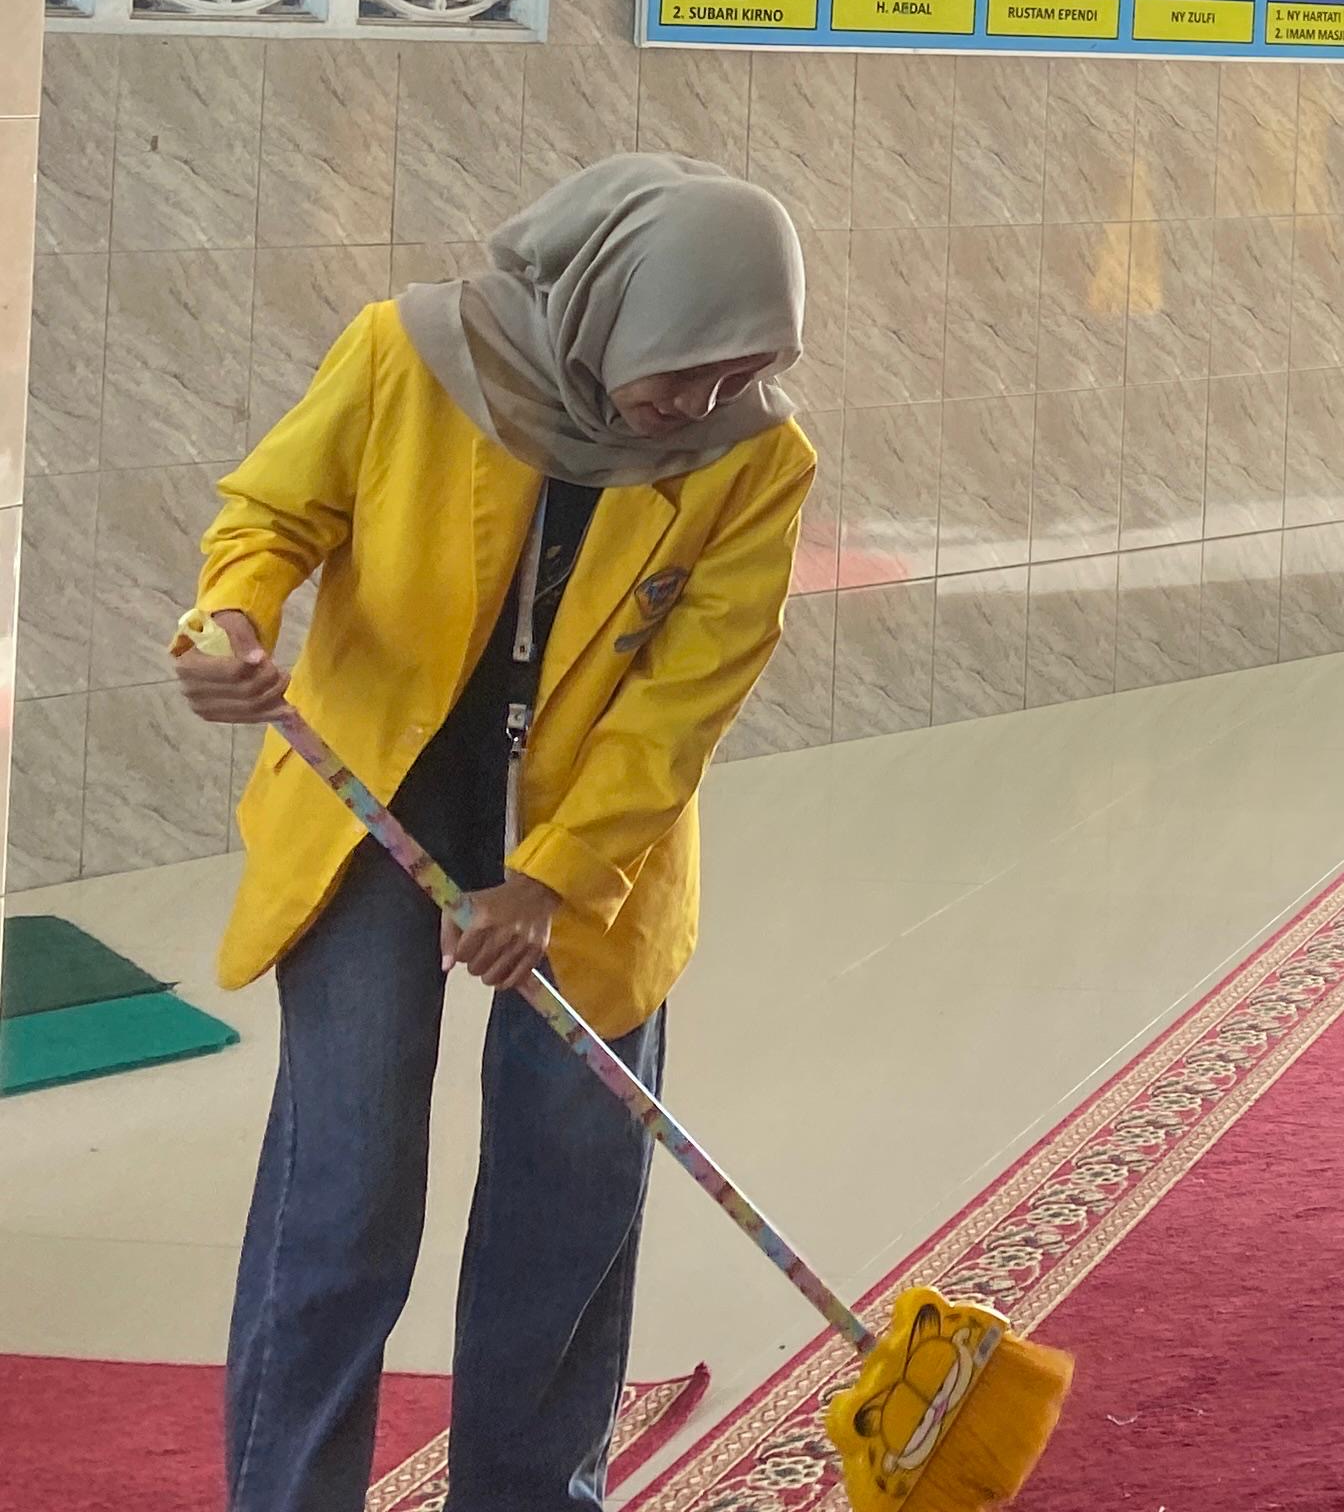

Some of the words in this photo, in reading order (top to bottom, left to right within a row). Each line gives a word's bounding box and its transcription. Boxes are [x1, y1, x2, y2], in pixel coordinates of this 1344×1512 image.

[876, 1, 888, 13] H.
[673, 6, 685, 19] 2.
[689, 7, 738, 21] SUBARI
[742, 9, 783, 22] KIRNO
[1008, 6, 1055, 20] RUSTAM
[1058, 8, 1098, 21] EPENDI
[1171, 11, 1185, 23] NY
[1188, 13, 1215, 23] ZULFI
[1287, 11, 1300, 21] NY
[1303, 11, 1341, 22] HARTATI
[1286, 29, 1315, 40] IMAM
